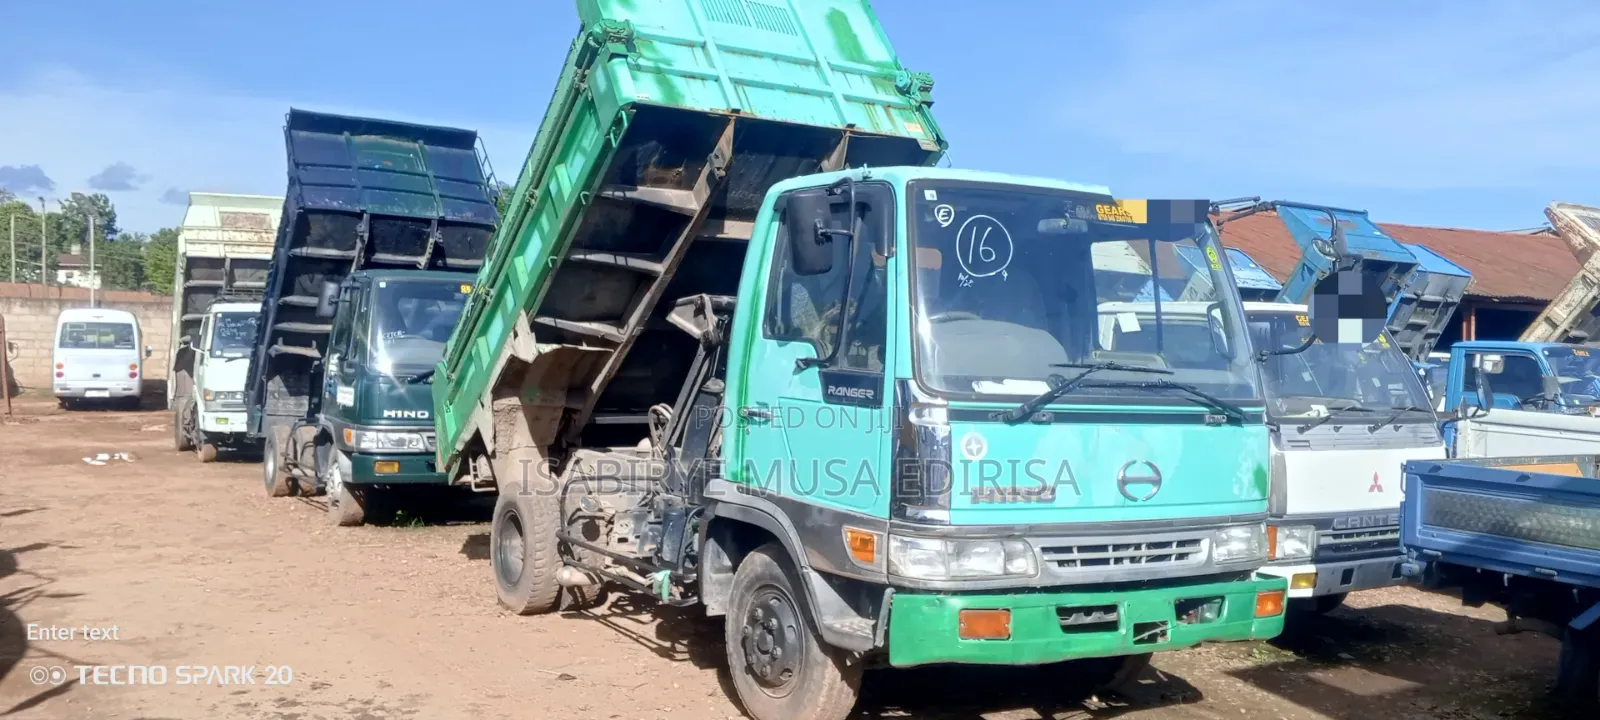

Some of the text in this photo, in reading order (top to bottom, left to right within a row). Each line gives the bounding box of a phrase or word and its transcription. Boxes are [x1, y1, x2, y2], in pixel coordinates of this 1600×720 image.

[968, 226, 996, 264] 16
[827, 385, 875, 400] RANGER
[383, 409, 429, 419] HINO
